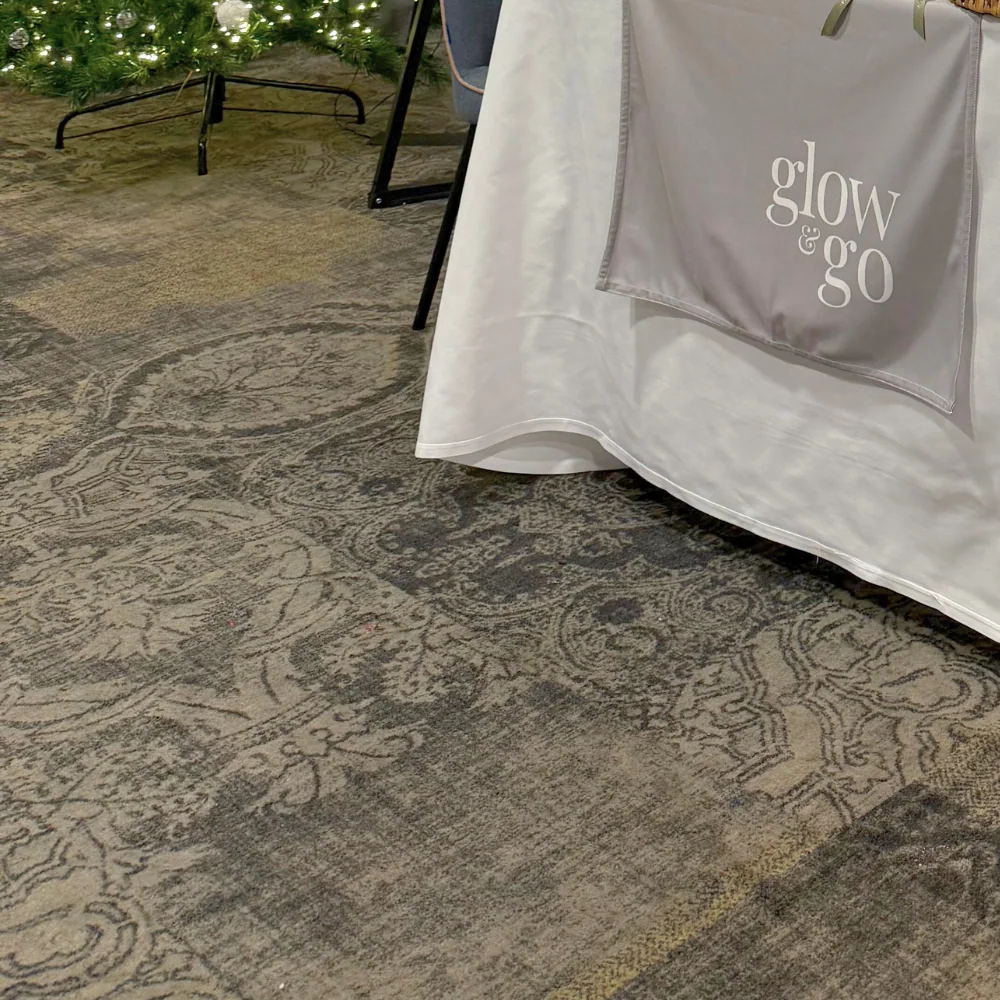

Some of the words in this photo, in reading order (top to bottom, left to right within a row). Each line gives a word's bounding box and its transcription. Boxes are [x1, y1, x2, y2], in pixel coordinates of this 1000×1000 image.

[765, 139, 901, 242] glow
[798, 224, 821, 255] &
[817, 235, 894, 308] go
